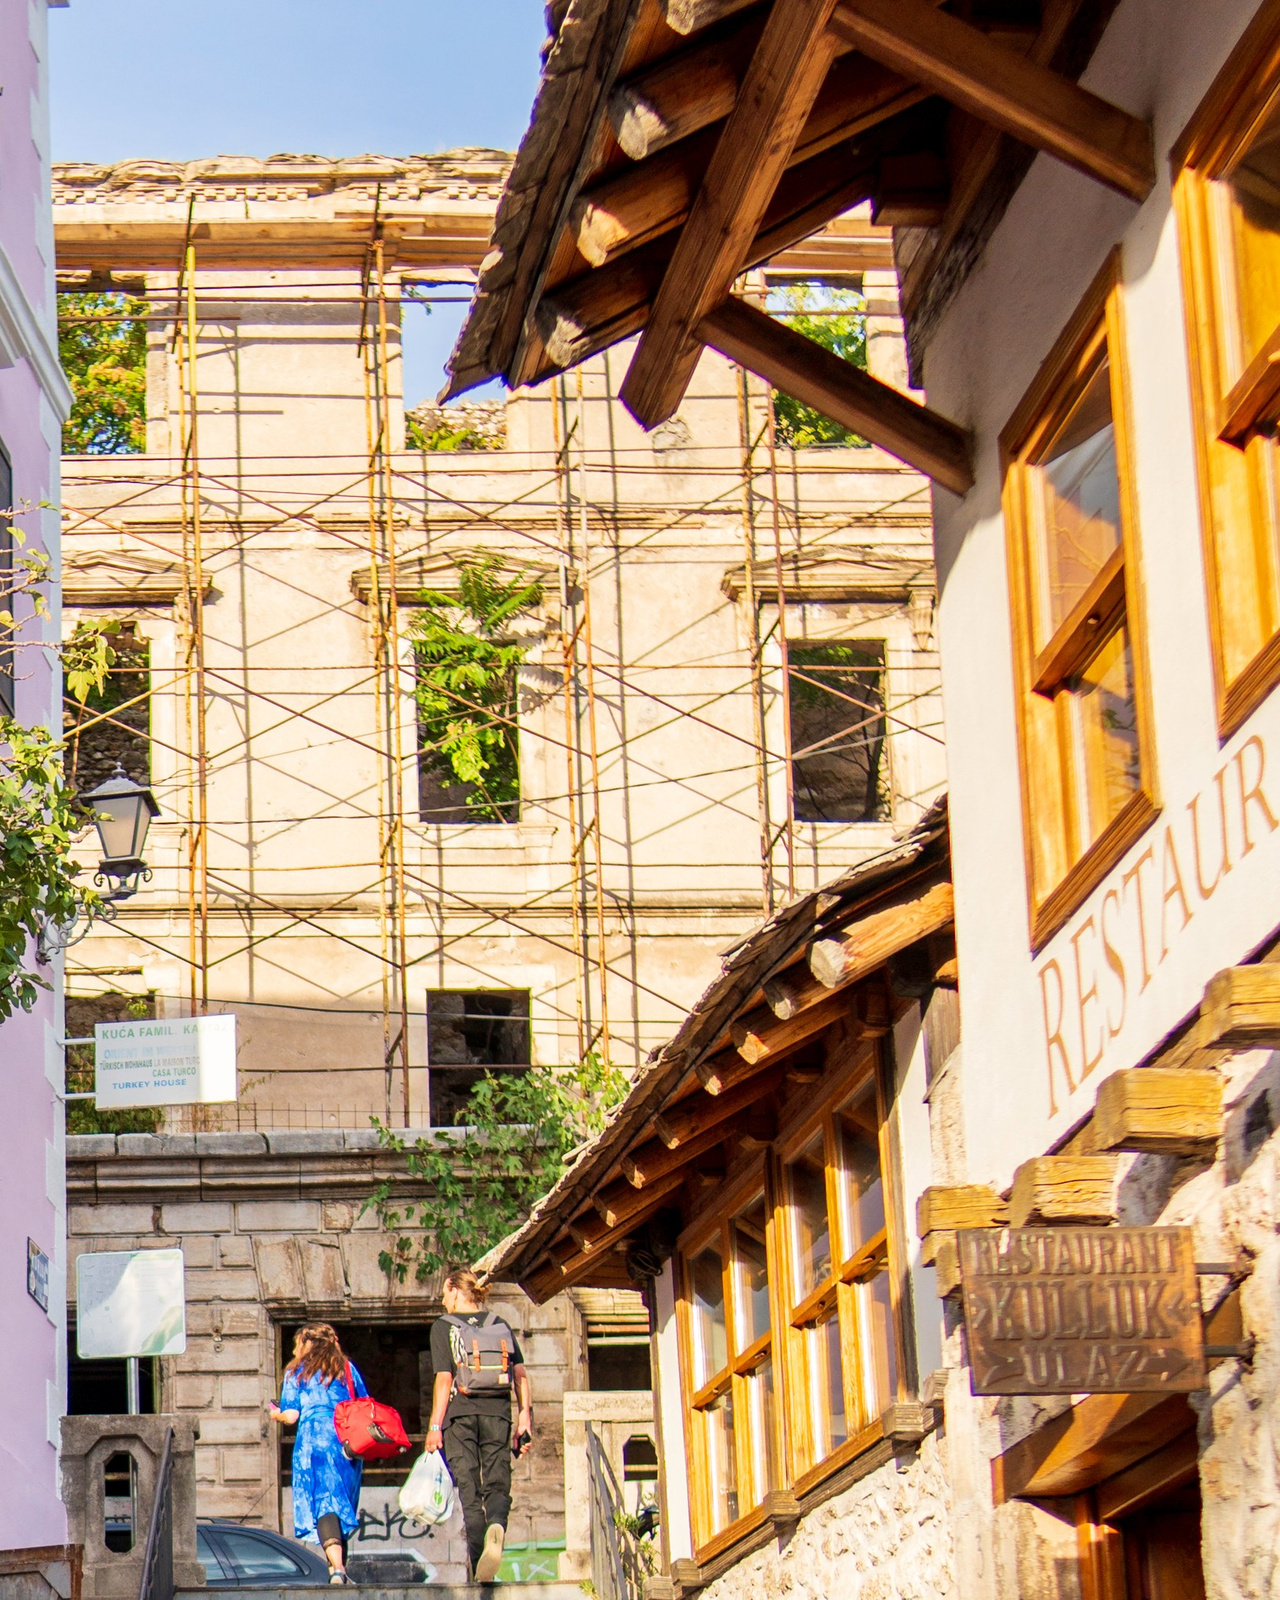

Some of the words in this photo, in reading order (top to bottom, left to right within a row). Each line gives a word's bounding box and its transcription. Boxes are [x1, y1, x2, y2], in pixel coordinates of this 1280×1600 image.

[102, 1026, 135, 1039] KUĆA
[152, 1068, 171, 1078] CASA
[173, 1067, 196, 1077] TURCO
[112, 1080, 150, 1090] TURKEY
[153, 1079, 187, 1088] HOUSE
[971, 1231, 1180, 1275] RESTAURANT
[987, 1279, 1172, 1340] KULLUK
